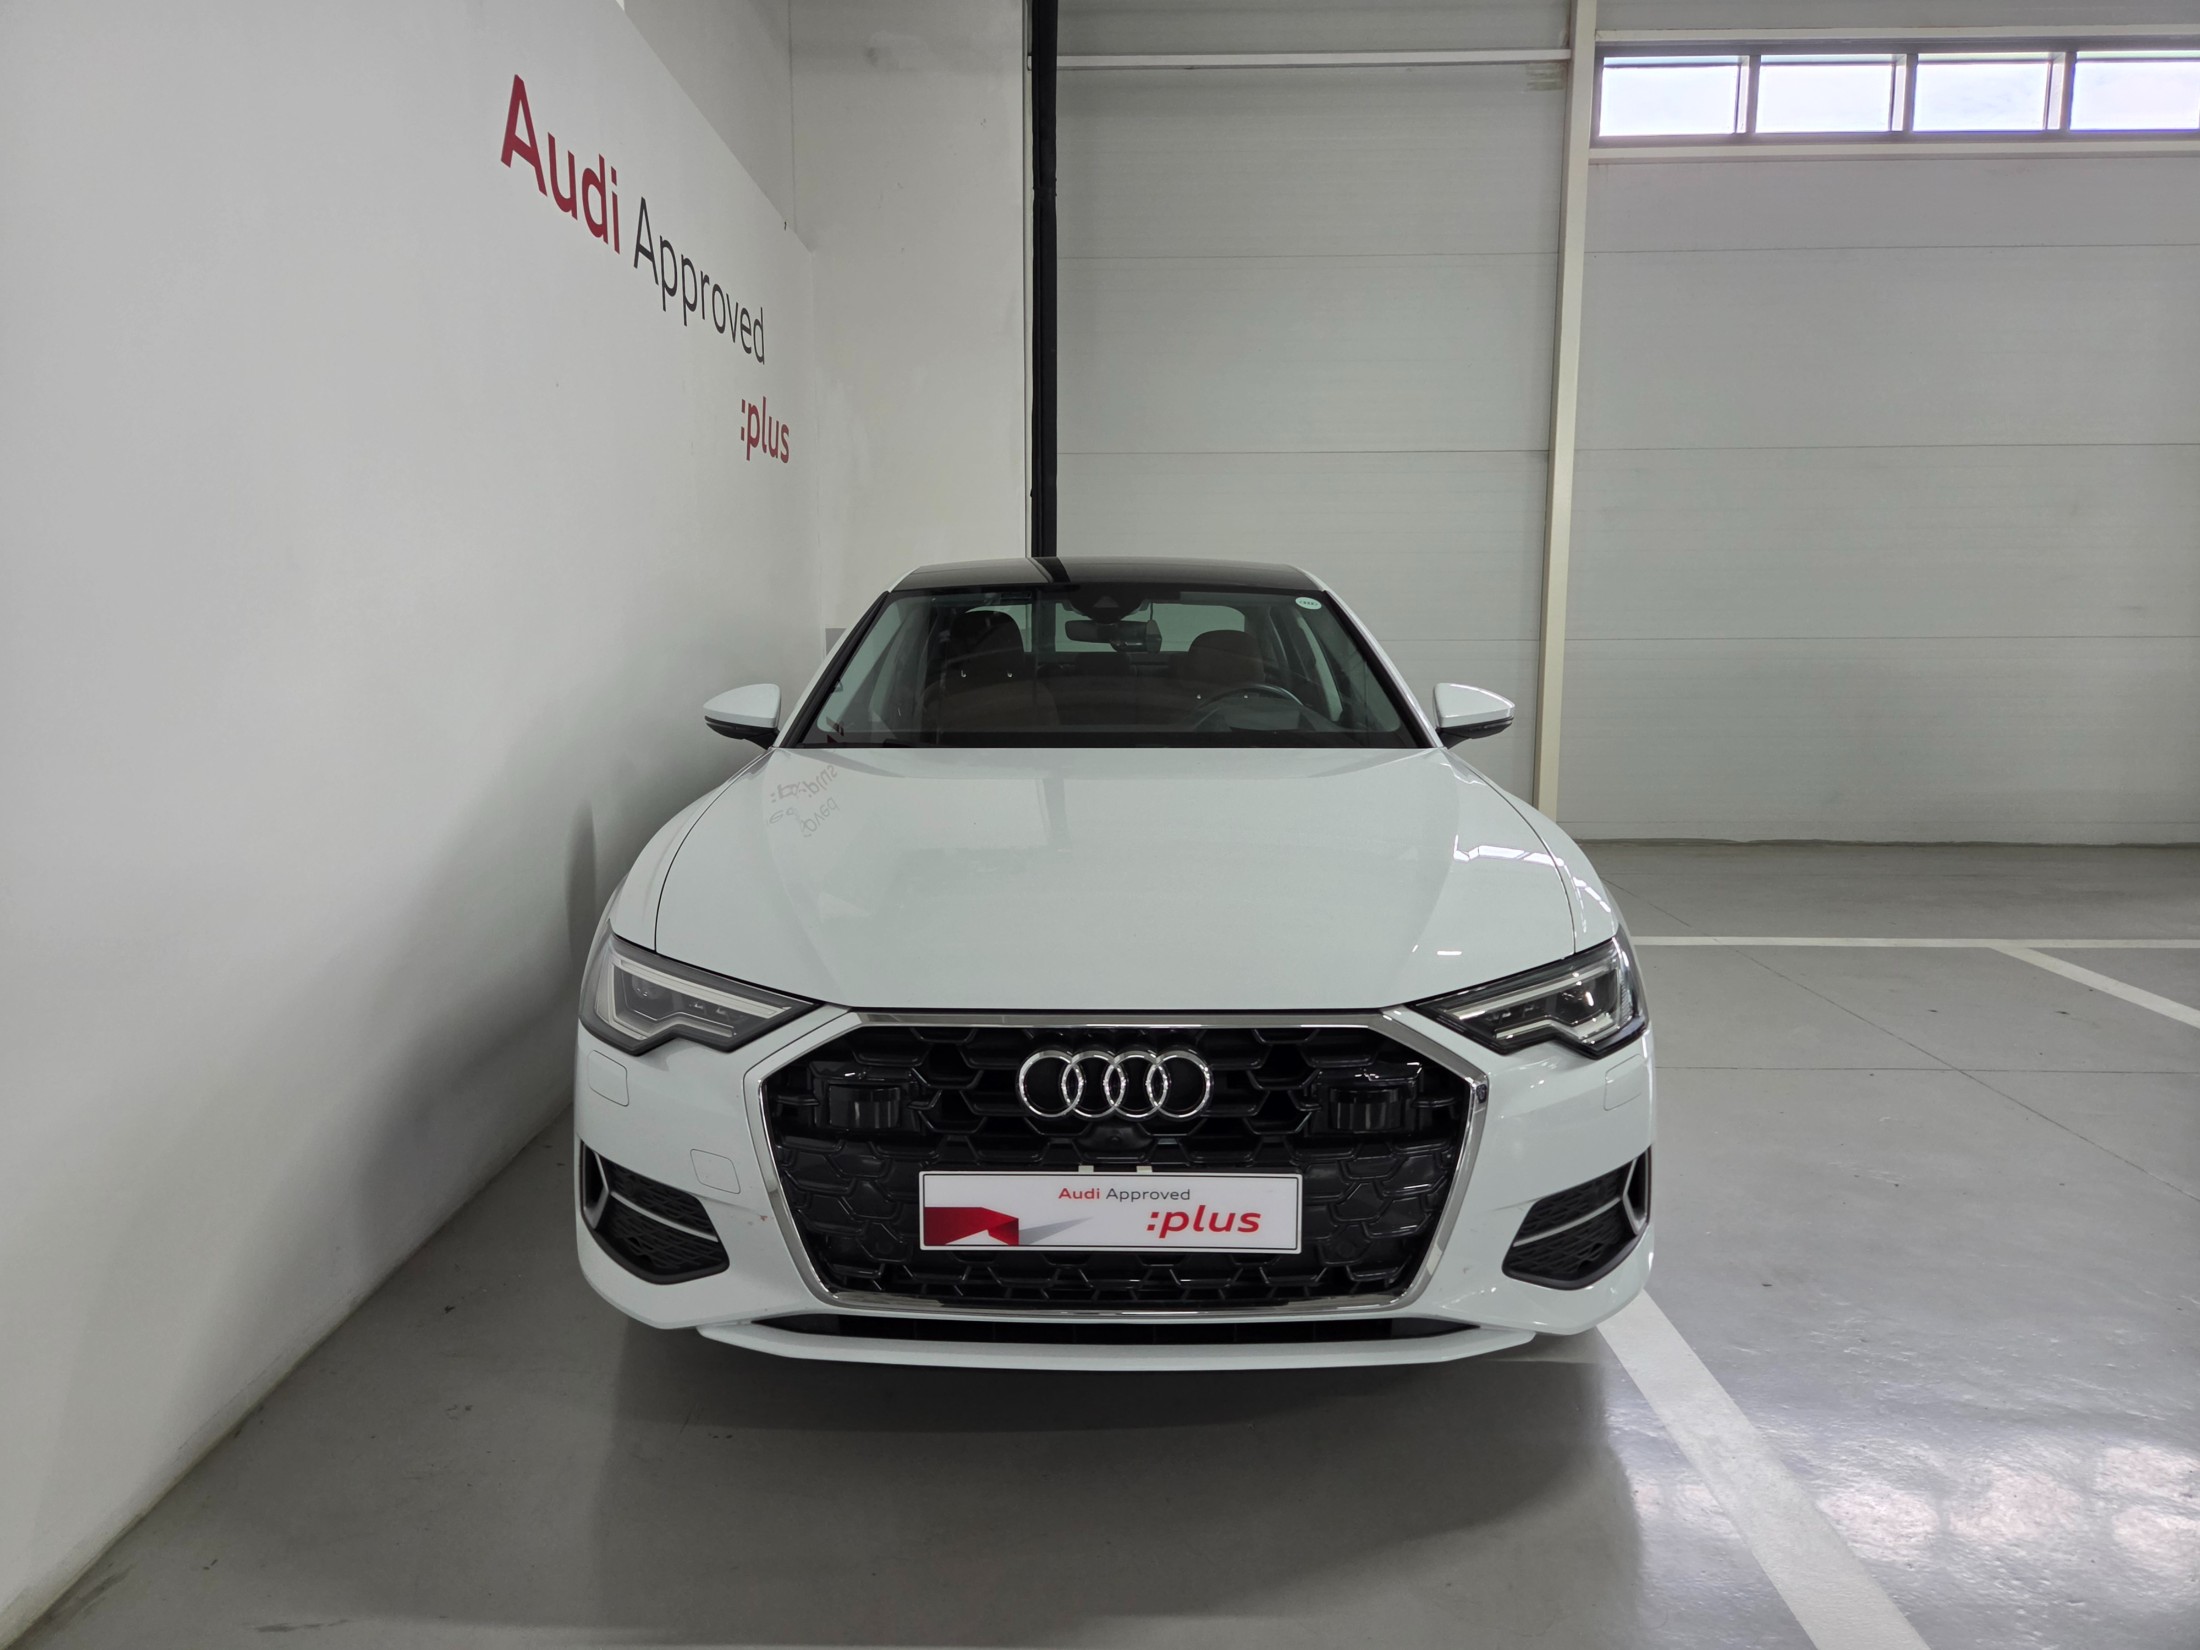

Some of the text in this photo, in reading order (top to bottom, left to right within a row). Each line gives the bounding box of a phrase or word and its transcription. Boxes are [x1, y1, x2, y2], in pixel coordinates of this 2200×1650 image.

[501, 74, 765, 365] Audi Approved
[1058, 1187, 1191, 1203] Audi Approved
